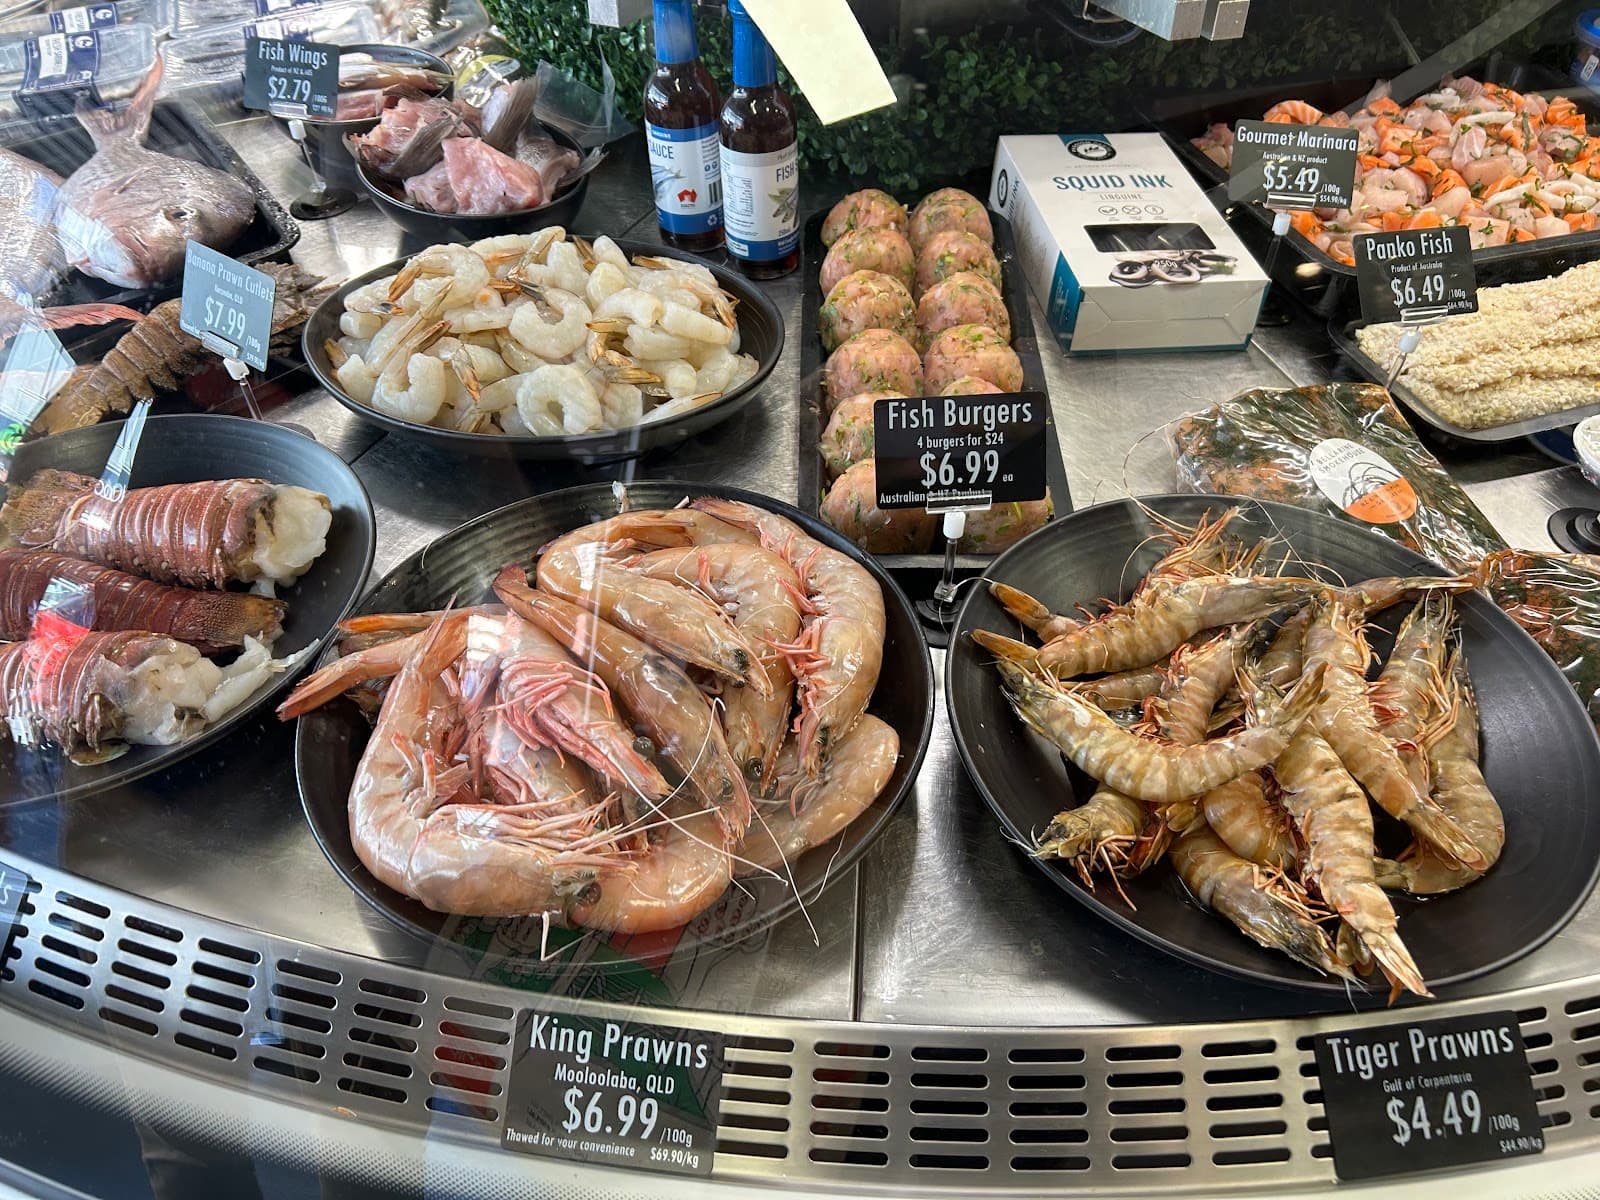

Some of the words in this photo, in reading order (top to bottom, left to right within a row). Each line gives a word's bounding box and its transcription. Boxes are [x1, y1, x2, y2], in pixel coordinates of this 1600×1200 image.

[258, 40, 284, 61] Fish
[288, 44, 328, 70] Wings
[268, 75, 311, 102] $2.79
[1237, 126, 1293, 146] Gourmet
[1296, 131, 1356, 151] Marinara
[1262, 152, 1292, 161] Australian
[1298, 154, 1306, 162] NZ
[1306, 156, 1328, 164] product
[776, 163, 794, 182] FISH
[1052, 175, 1124, 191] SQUID
[1129, 174, 1173, 188] INK
[1262, 165, 1320, 192] $5.49
[1320, 184, 1340, 195] /100g
[1366, 234, 1416, 260] Panko
[1420, 231, 1452, 256] Fish
[186, 249, 216, 276] Banana
[218, 262, 242, 288] Prawn
[246, 275, 274, 302] Cutlets
[1391, 264, 1411, 273] Product
[1412, 262, 1418, 270] of
[1420, 261, 1442, 270] Australia
[1391, 274, 1444, 308] $6.49
[1448, 289, 1466, 299] /100g
[204, 296, 246, 340] $7.99
[888, 400, 934, 430] Fish
[944, 400, 1032, 432] Burgers
[917, 436, 923, 448] 4
[926, 435, 964, 450] burgers
[967, 434, 982, 446] for
[920, 450, 999, 489] $6.99
[1002, 473, 1014, 482] ea
[880, 492, 926, 504] Australian
[530, 1014, 593, 1064] King
[602, 1023, 708, 1069] Prawns
[1326, 1036, 1400, 1080] Tiger
[1408, 1027, 1514, 1064] Prawns
[554, 1063, 642, 1092] Mooloolaba,
[646, 1075, 675, 1094] QLD
[1382, 1079, 1402, 1093] Gulf
[1405, 1078, 1416, 1090] of
[1418, 1072, 1473, 1090] Carpentaria
[562, 1086, 659, 1140] $6.99
[1386, 1088, 1482, 1147] $4.49
[1488, 1114, 1520, 1136] /100g
[506, 1128, 539, 1146] Thawed
[541, 1131, 554, 1146] for
[557, 1137, 576, 1151] your
[580, 1140, 635, 1157] convenience
[659, 1127, 693, 1148] /100g
[1500, 1134, 1543, 1153] $44.90/kg
[650, 1147, 699, 1168] $69.90/kg
